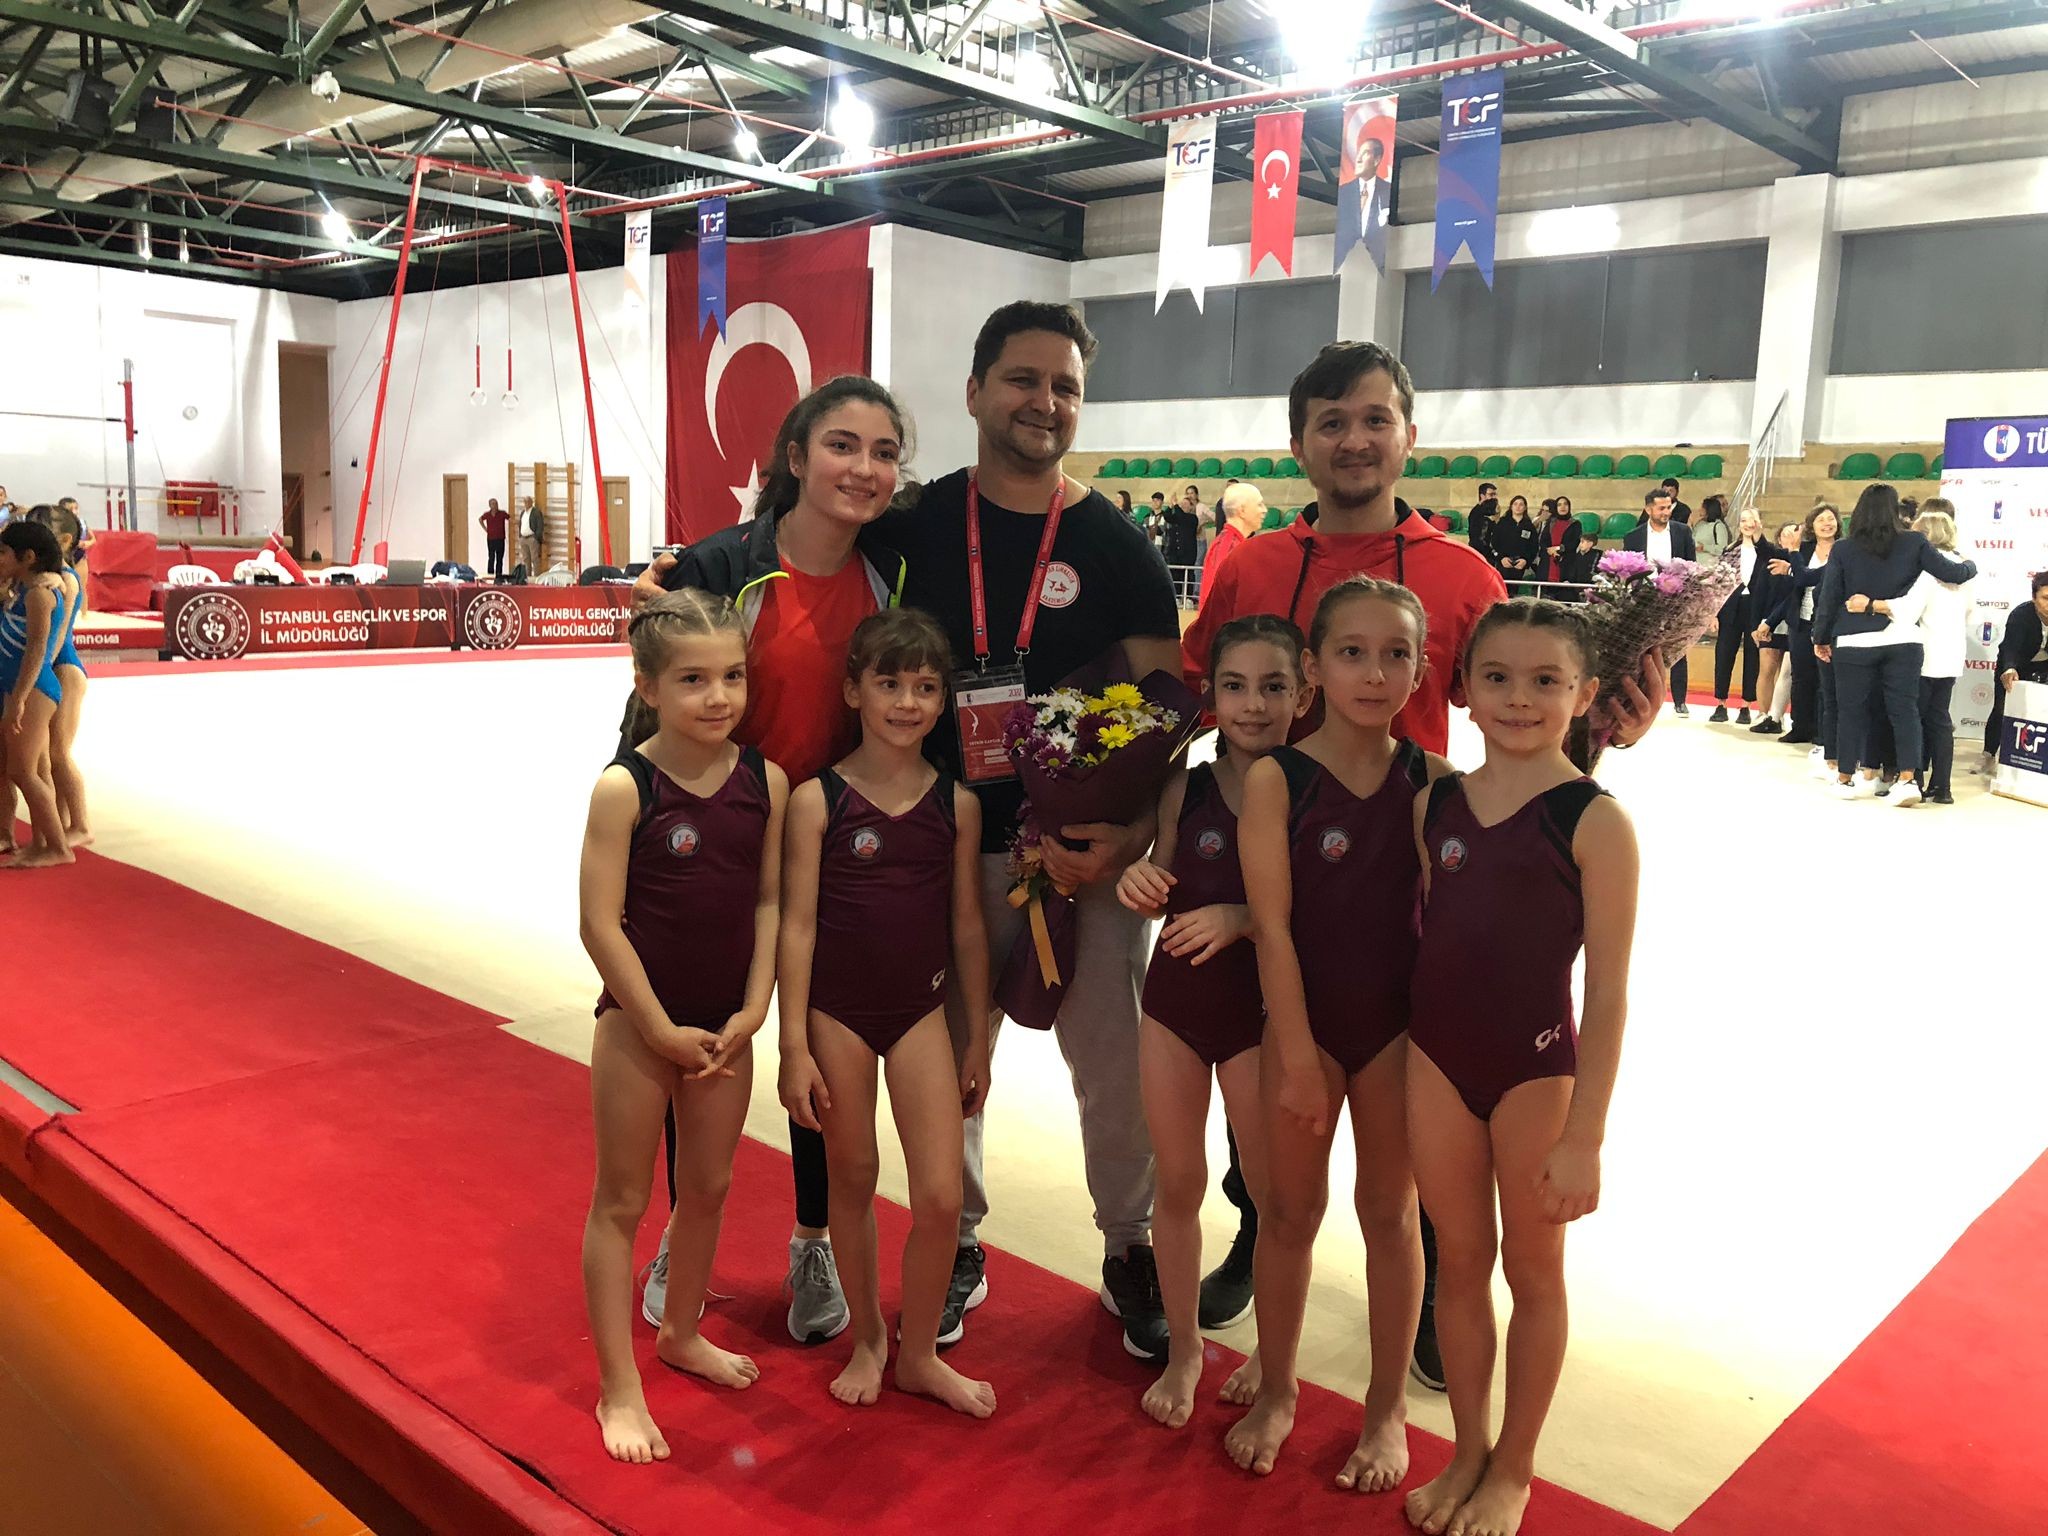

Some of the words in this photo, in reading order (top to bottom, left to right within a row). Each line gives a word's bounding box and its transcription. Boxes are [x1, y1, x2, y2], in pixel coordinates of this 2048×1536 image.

[1447, 92, 1499, 127] TCF
[1172, 138, 1212, 166] TCF
[700, 211, 725, 234] TCF
[627, 225, 649, 243] TCF
[1974, 539, 2014, 549] VESTEL
[260, 608, 331, 625] İSTANBUL
[333, 606, 392, 626] GENÇLİK
[393, 608, 410, 622] VE
[412, 608, 447, 622] SPOR
[529, 605, 585, 620] İSTANBUL
[586, 605, 632, 622] GENÇLİK
[260, 628, 274, 644] İL
[276, 626, 369, 643] MÜDÜRLÜĞÜ
[529, 623, 540, 637] İL
[541, 622, 615, 637] MÜDÜRLÜĞÜ
[1964, 659, 1998, 671] VESTE
[2012, 721, 2048, 753] TCF
